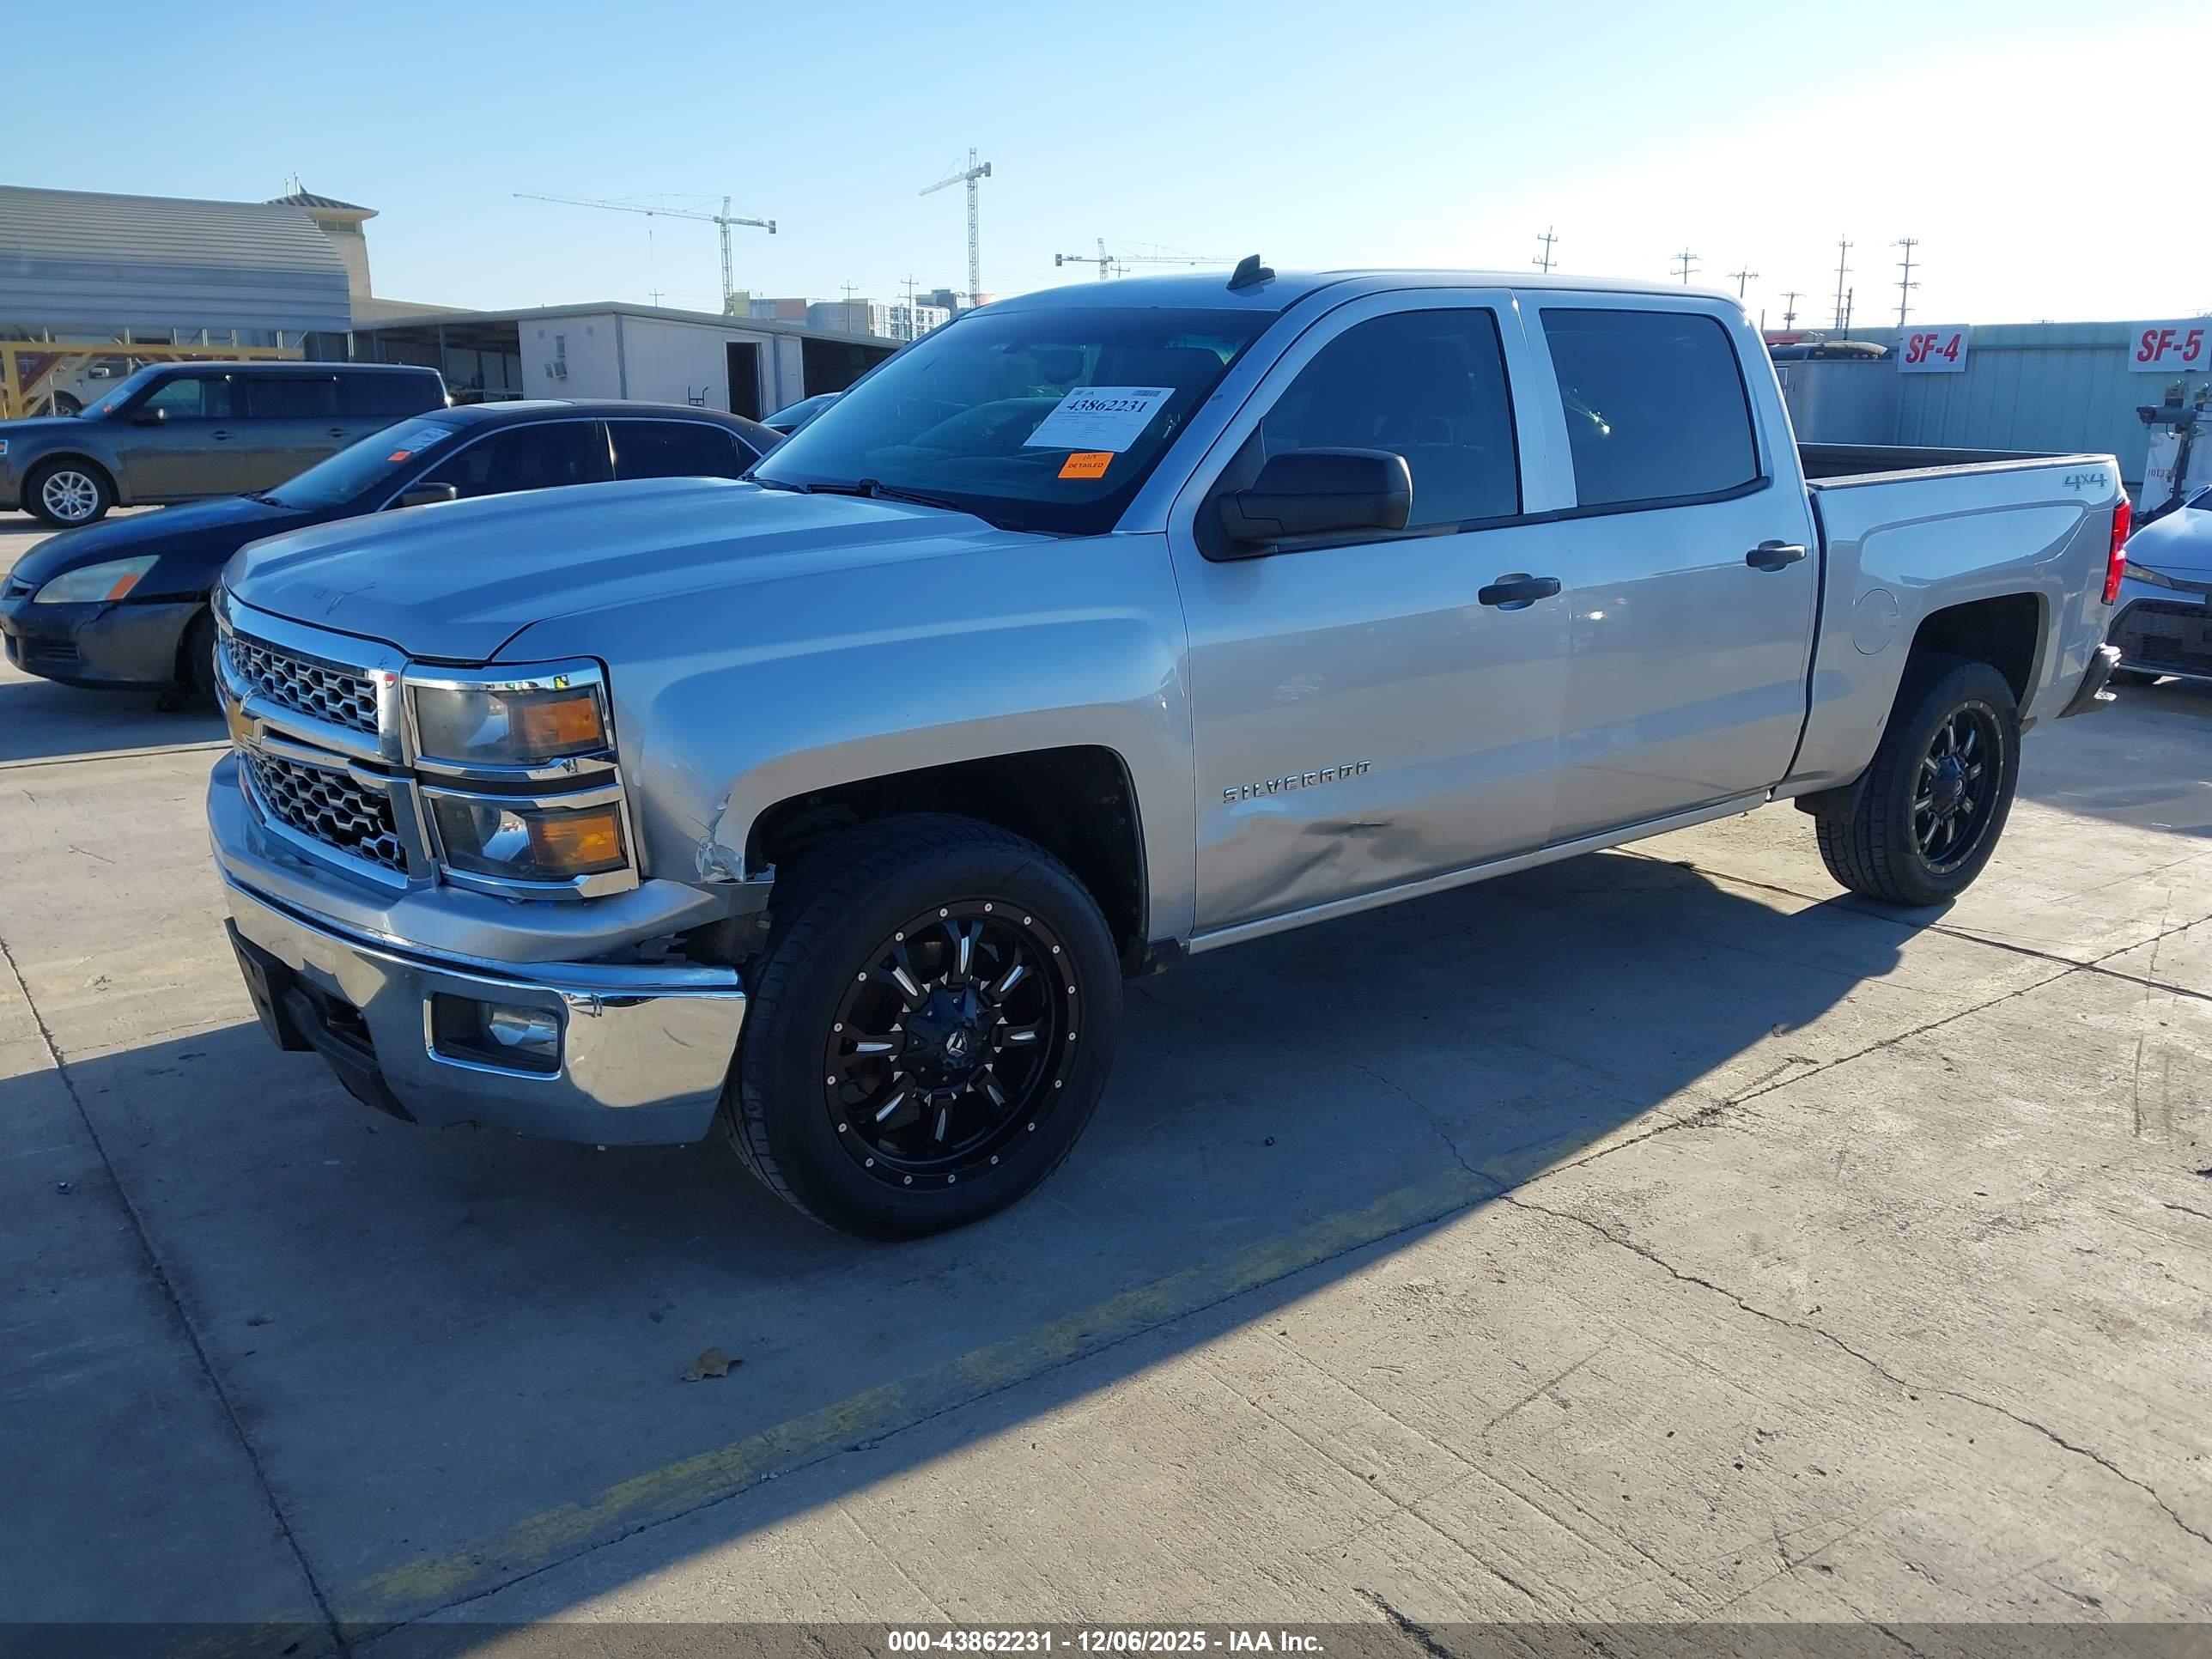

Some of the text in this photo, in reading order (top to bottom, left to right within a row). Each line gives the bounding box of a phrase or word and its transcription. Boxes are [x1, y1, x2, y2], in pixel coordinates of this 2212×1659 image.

[1905, 333, 1961, 363] SF-4
[2136, 329, 2205, 362] SF-5
[1066, 399, 1148, 413] 43862231
[1223, 761, 1371, 804] SILVERADO
